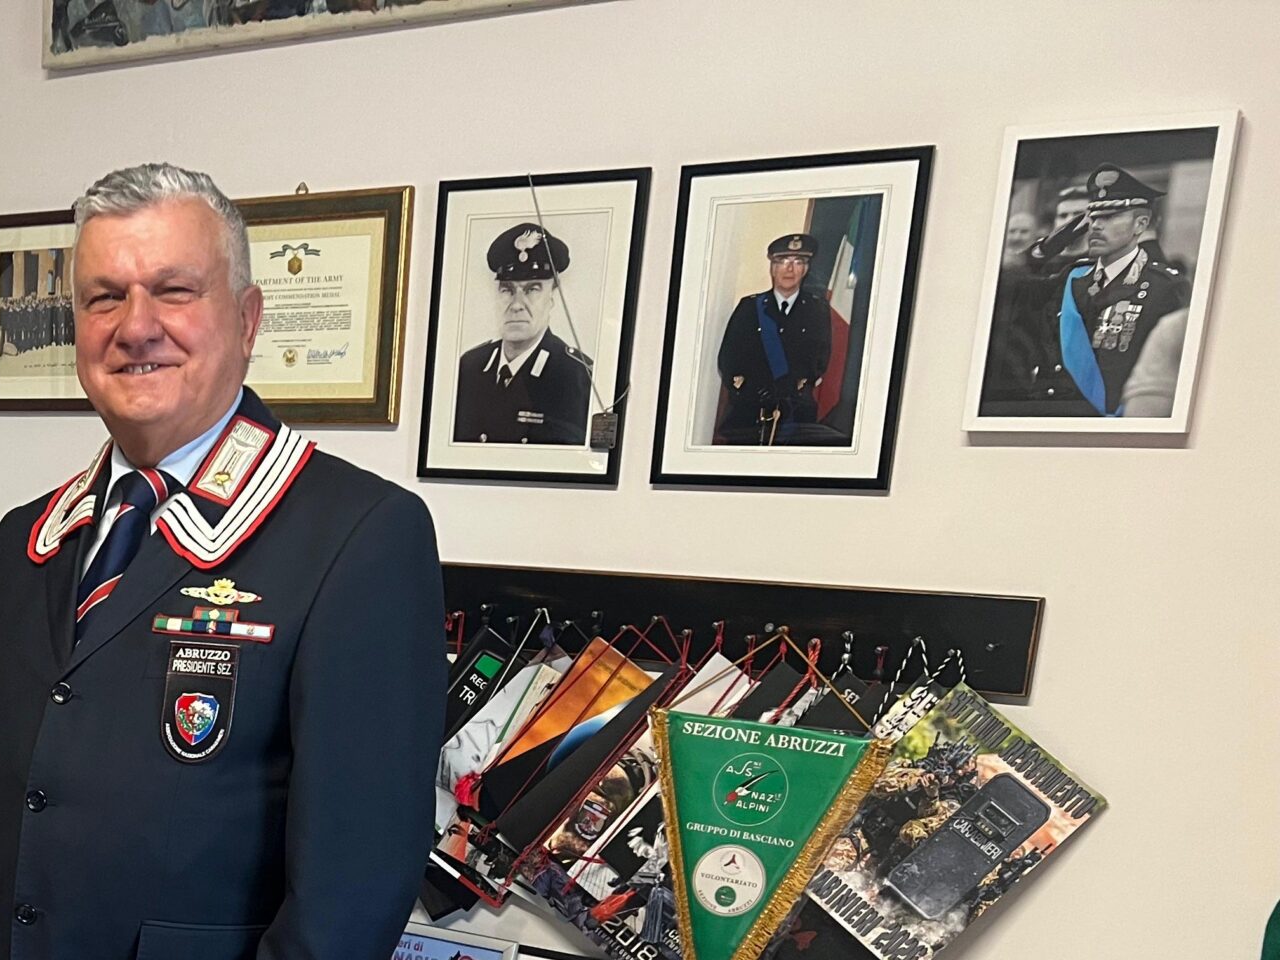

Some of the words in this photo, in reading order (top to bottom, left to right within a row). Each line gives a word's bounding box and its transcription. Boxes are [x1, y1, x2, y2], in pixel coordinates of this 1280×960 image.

[324, 275, 343, 283] ARMY
[175, 647, 231, 660] ABRUZZO
[172, 659, 216, 674] PRESIDENTE
[840, 688, 861, 705] SET
[682, 721, 761, 745] SEZIONE
[765, 733, 847, 757] ABRUZZI
[735, 800, 770, 814] ALPINI
[686, 821, 728, 836] GRUPPO
[729, 830, 741, 839] DI
[742, 831, 795, 848] BASCIANO
[700, 872, 758, 889] VOLONTARIATO
[809, 869, 885, 938] ABINIERI
[397, 938, 411, 950] eri
[414, 940, 424, 952] di
